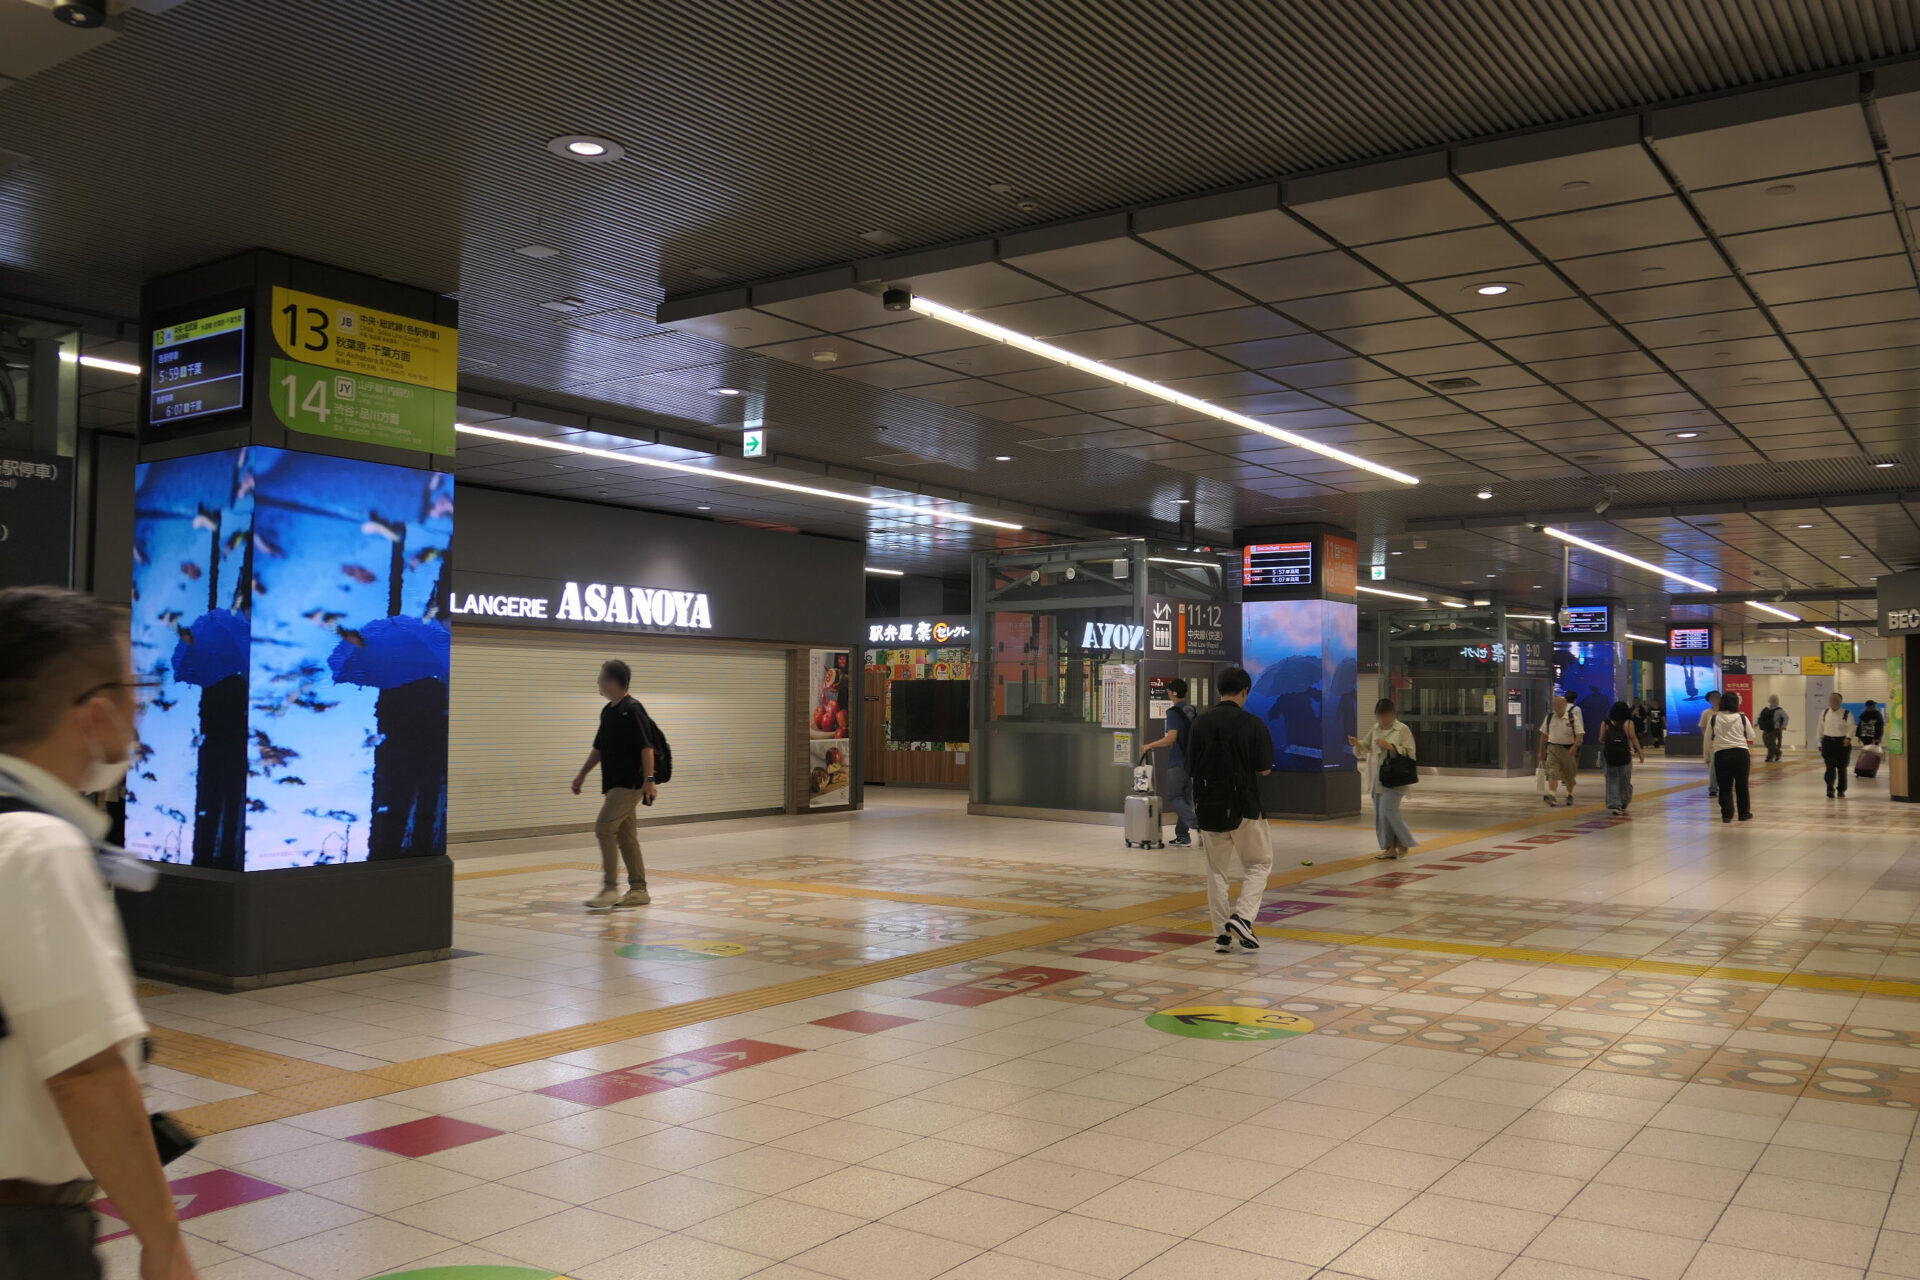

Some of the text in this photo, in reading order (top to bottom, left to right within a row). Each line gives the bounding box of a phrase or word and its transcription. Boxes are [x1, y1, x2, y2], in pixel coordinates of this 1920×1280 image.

[282, 304, 329, 351] 13
[340, 316, 352, 327] JB
[159, 367, 179, 383] 5:59
[339, 383, 351, 393] JY
[281, 374, 331, 423] 14
[0, 459, 58, 481] 駅停車)
[555, 582, 712, 629] ASANOYA
[1256, 1014, 1300, 1025] 13
[1222, 1027, 1272, 1039] 14
